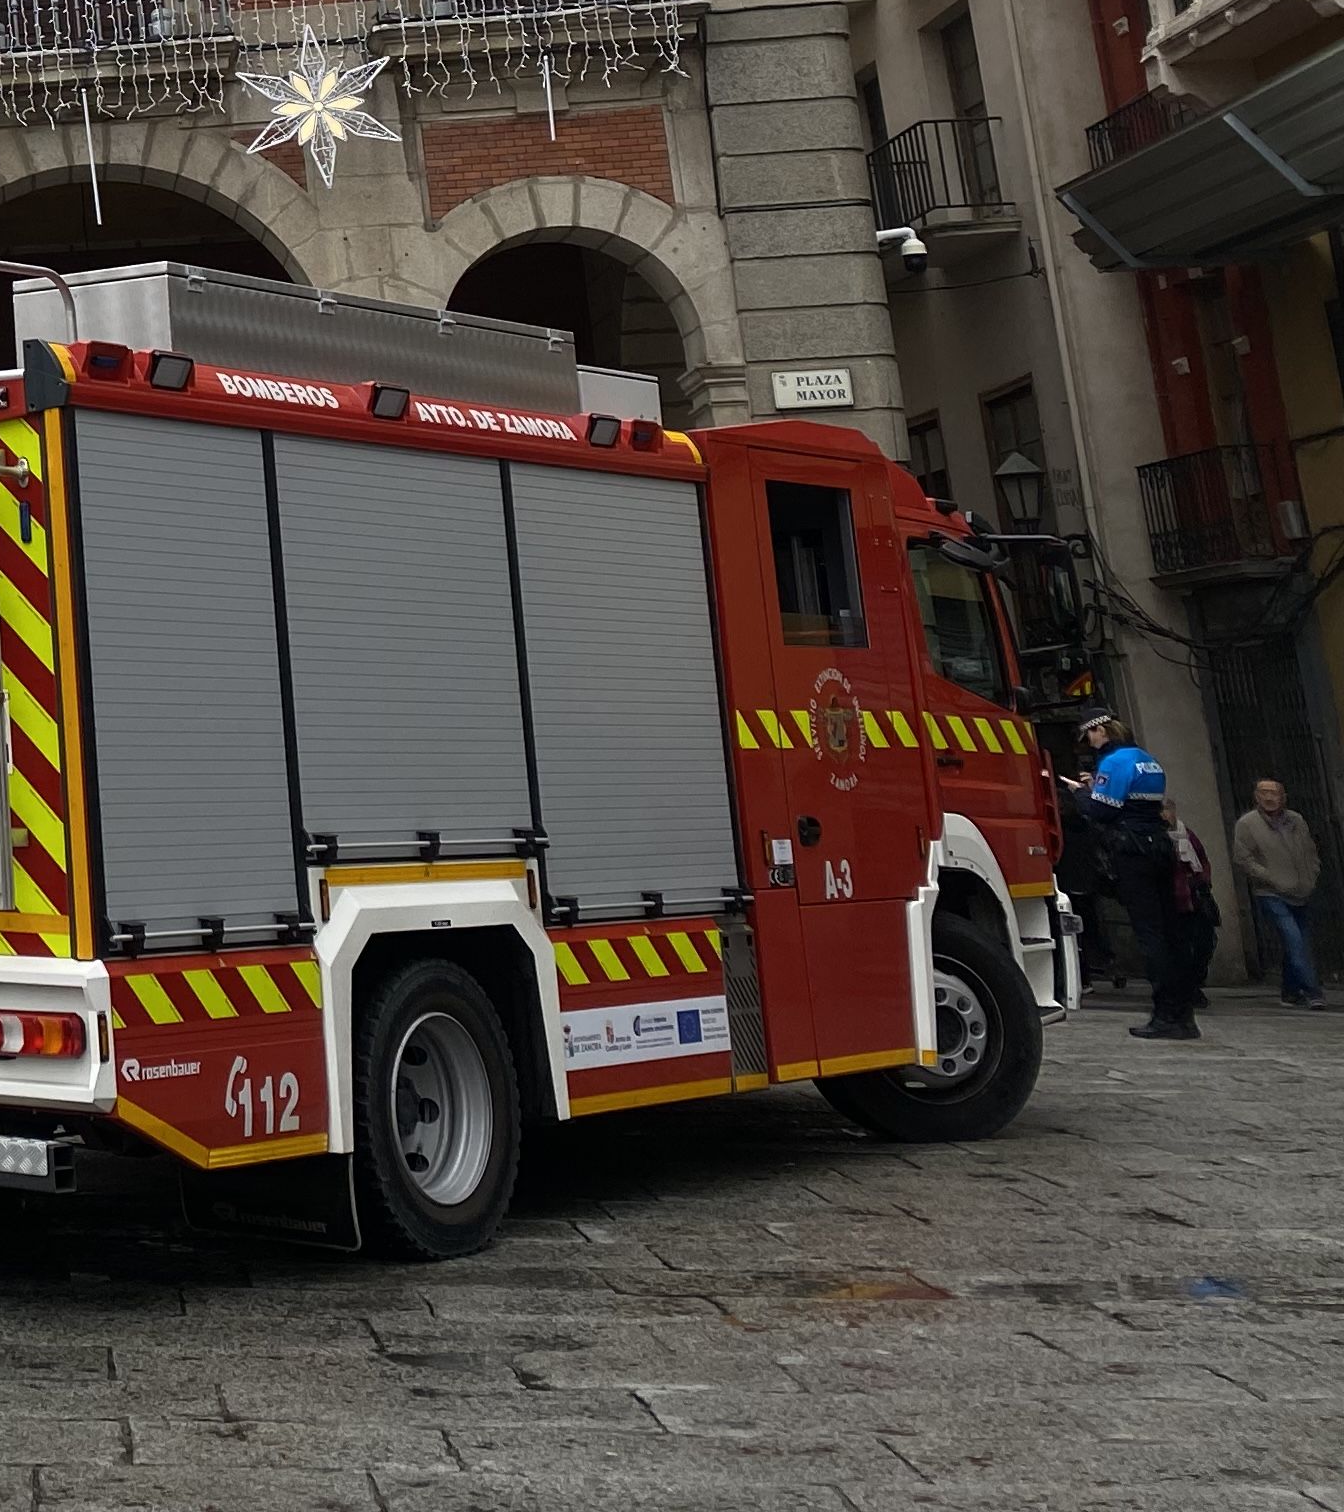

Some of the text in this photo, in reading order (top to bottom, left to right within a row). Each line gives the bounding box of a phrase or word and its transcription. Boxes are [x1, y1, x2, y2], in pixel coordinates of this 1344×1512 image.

[216, 372, 340, 409] BOMBEROS
[796, 375, 842, 386] PLAZA
[797, 389, 846, 401] MAYOR
[414, 401, 577, 441] AYTO. DE ZAMORA
[825, 859, 853, 899] A-3
[141, 1059, 201, 1081] rosenbauer
[238, 1072, 300, 1137] 112
